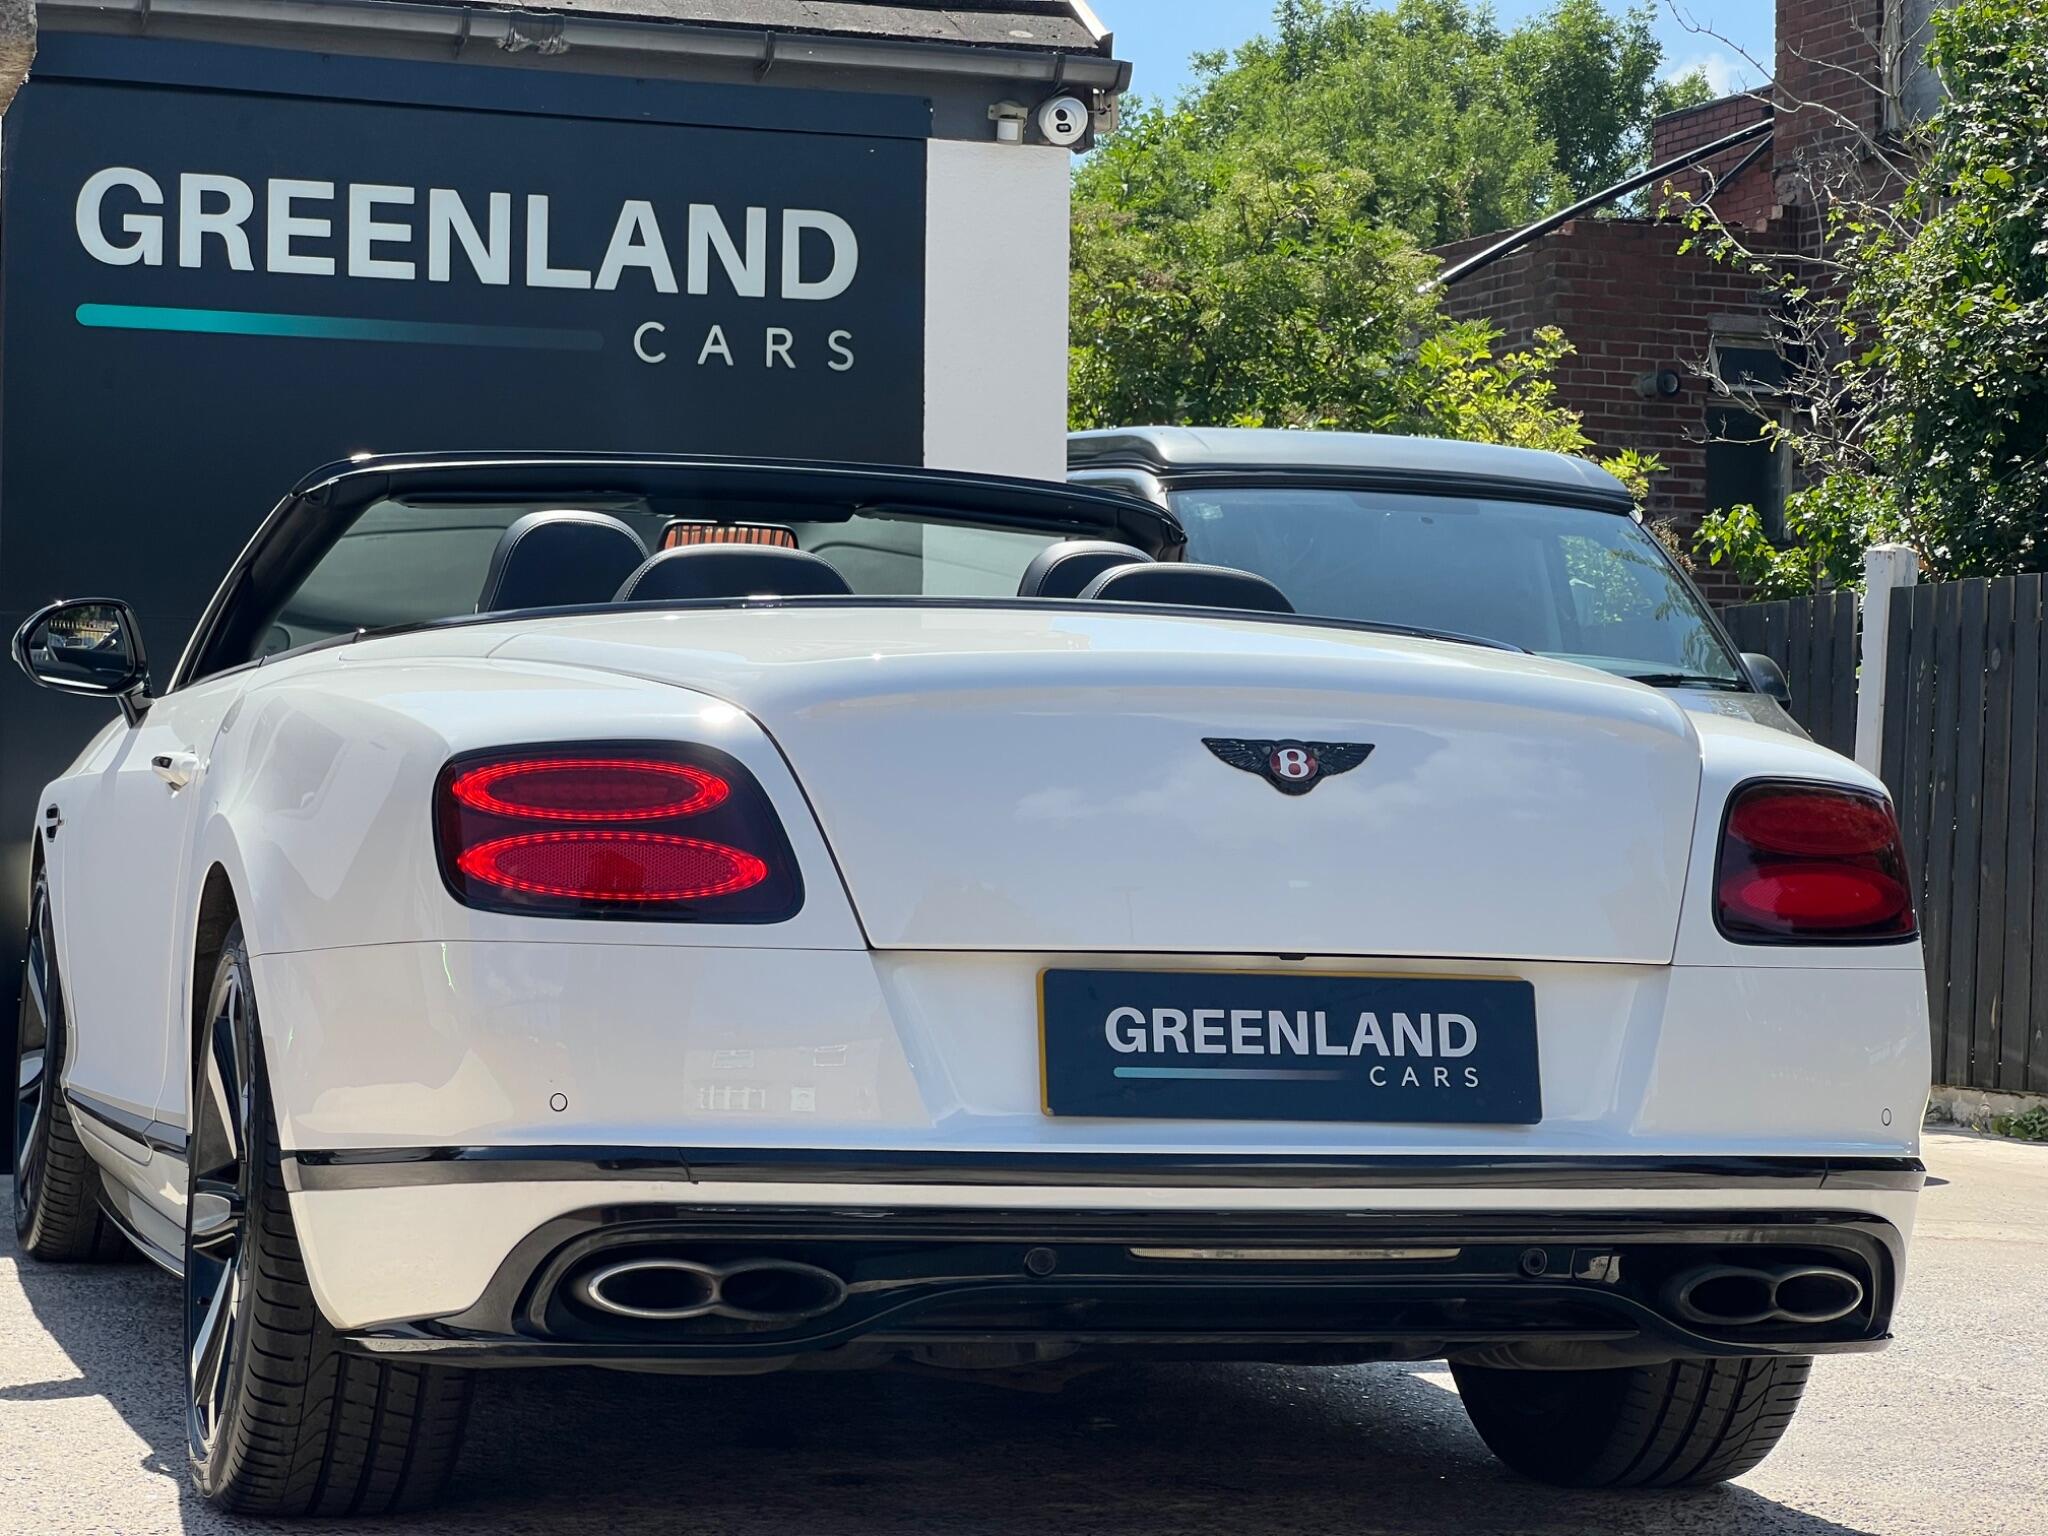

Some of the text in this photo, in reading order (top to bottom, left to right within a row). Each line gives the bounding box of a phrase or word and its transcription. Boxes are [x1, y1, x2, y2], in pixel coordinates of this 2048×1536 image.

[75, 166, 859, 301] GREENLAND
[633, 321, 856, 372] CARS
[1277, 748, 1309, 778] B
[1105, 1006, 1478, 1058] GREENLAND
[1369, 1065, 1479, 1088] CARS
